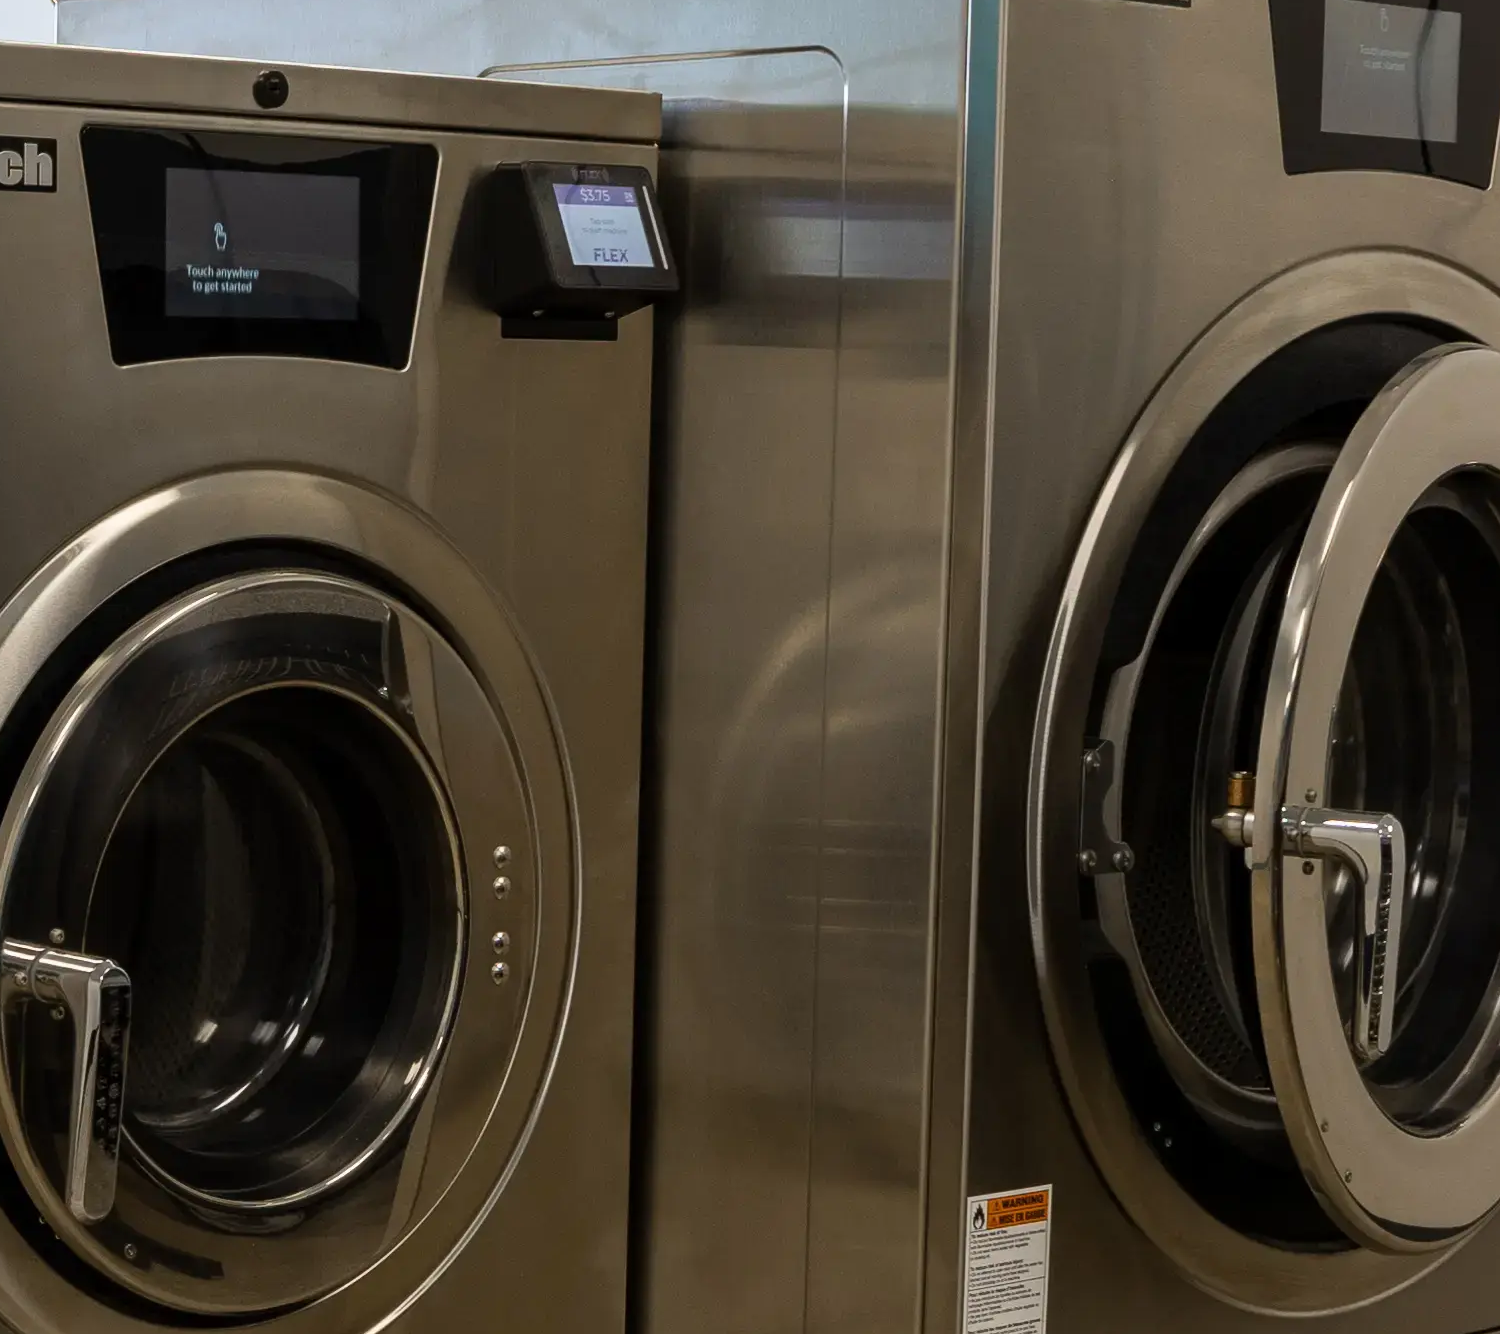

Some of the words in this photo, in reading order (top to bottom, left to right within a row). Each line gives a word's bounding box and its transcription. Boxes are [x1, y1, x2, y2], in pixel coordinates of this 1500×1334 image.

[580, 187, 611, 203] $3.75
[594, 248, 629, 263] FLEX
[186, 264, 214, 277] Touch
[216, 266, 259, 280] anywhere
[192, 280, 202, 292] to
[204, 281, 218, 294] get
[221, 281, 252, 293] started
[1002, 1194, 1044, 1209] WARNING
